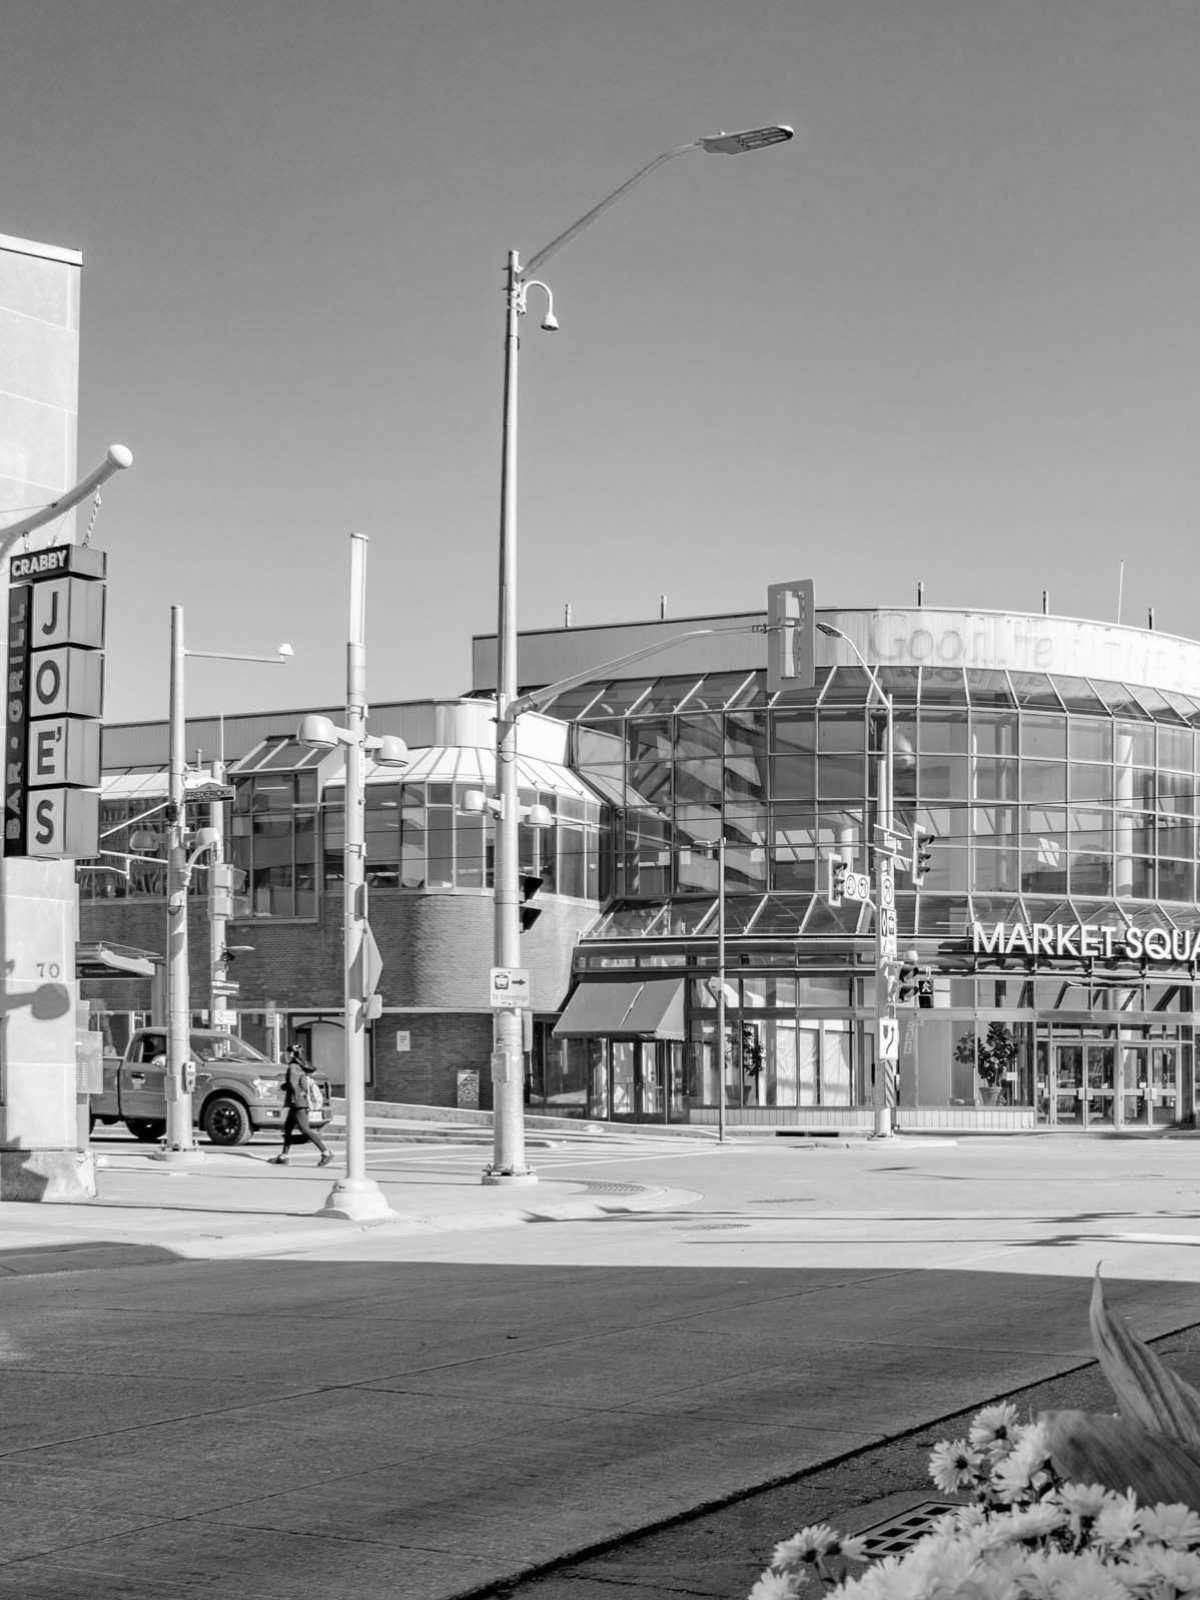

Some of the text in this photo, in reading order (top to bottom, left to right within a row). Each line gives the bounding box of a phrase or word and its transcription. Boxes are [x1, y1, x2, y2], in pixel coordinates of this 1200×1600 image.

[12, 550, 67, 576] CRABBY
[6, 603, 25, 839] BAR GRILL
[35, 591, 62, 845] JOE'S
[185, 789, 226, 799] FREDERICK
[973, 921, 1117, 958] MARKET
[36, 963, 60, 978] 70
